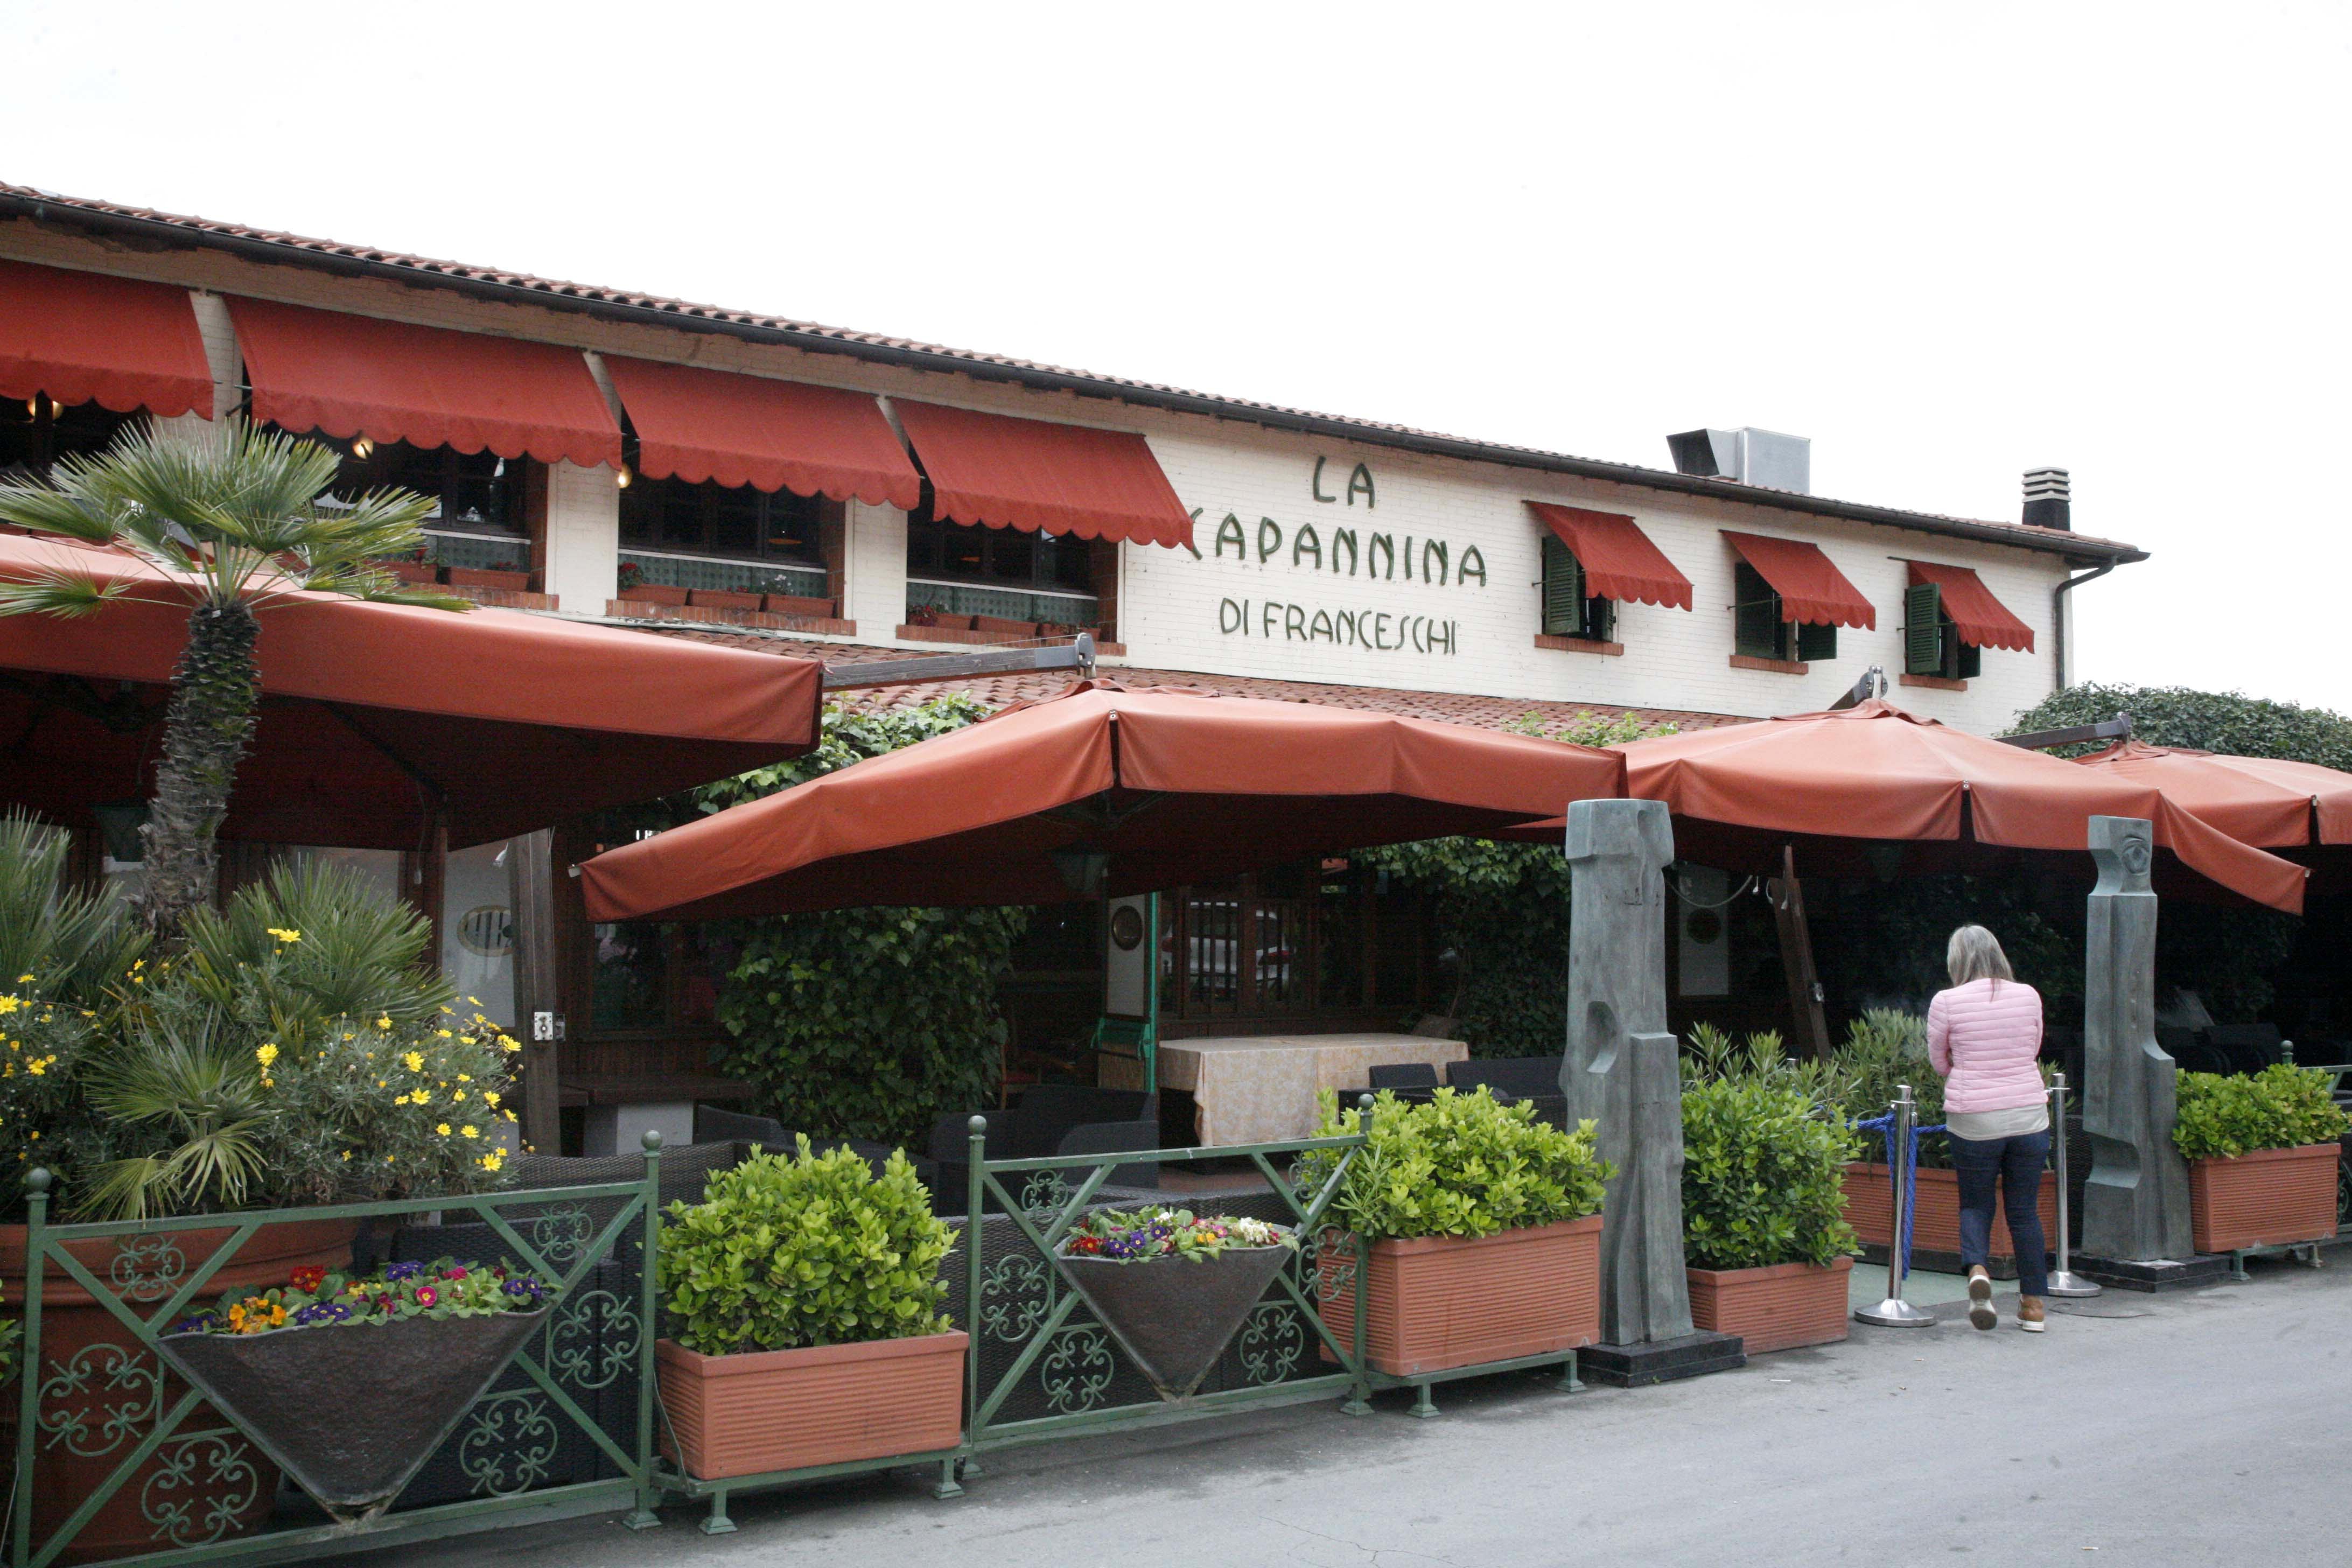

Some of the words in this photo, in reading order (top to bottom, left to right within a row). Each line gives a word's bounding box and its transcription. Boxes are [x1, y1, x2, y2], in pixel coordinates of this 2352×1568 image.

[1313, 456, 1375, 508] LA
[1220, 597, 1249, 635] DI
[1264, 601, 1456, 655] FRANCESCHI
